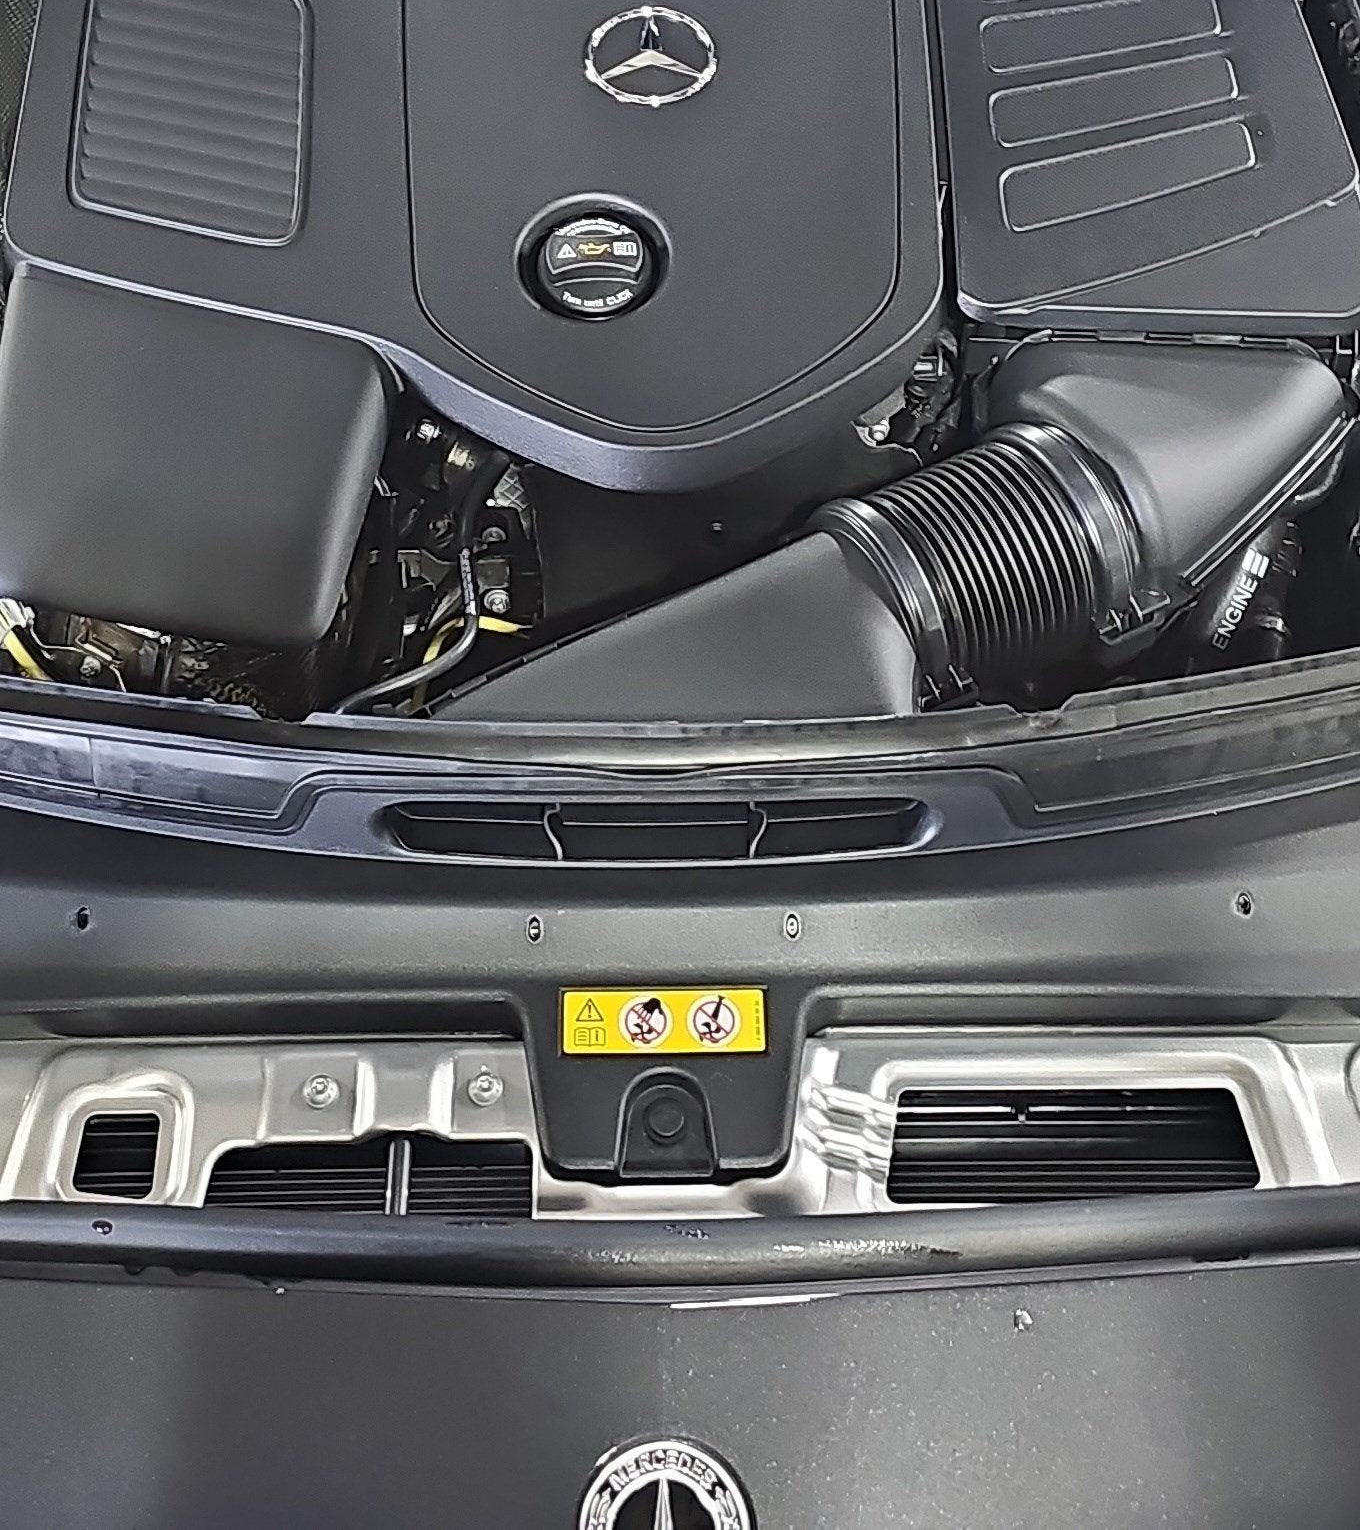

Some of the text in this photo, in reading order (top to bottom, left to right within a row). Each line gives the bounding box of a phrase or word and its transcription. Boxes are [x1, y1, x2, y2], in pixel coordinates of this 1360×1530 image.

[606, 288, 634, 306] CLICK
[1212, 573, 1258, 650] ENGINE
[609, 1449, 718, 1491] MERCEDES
